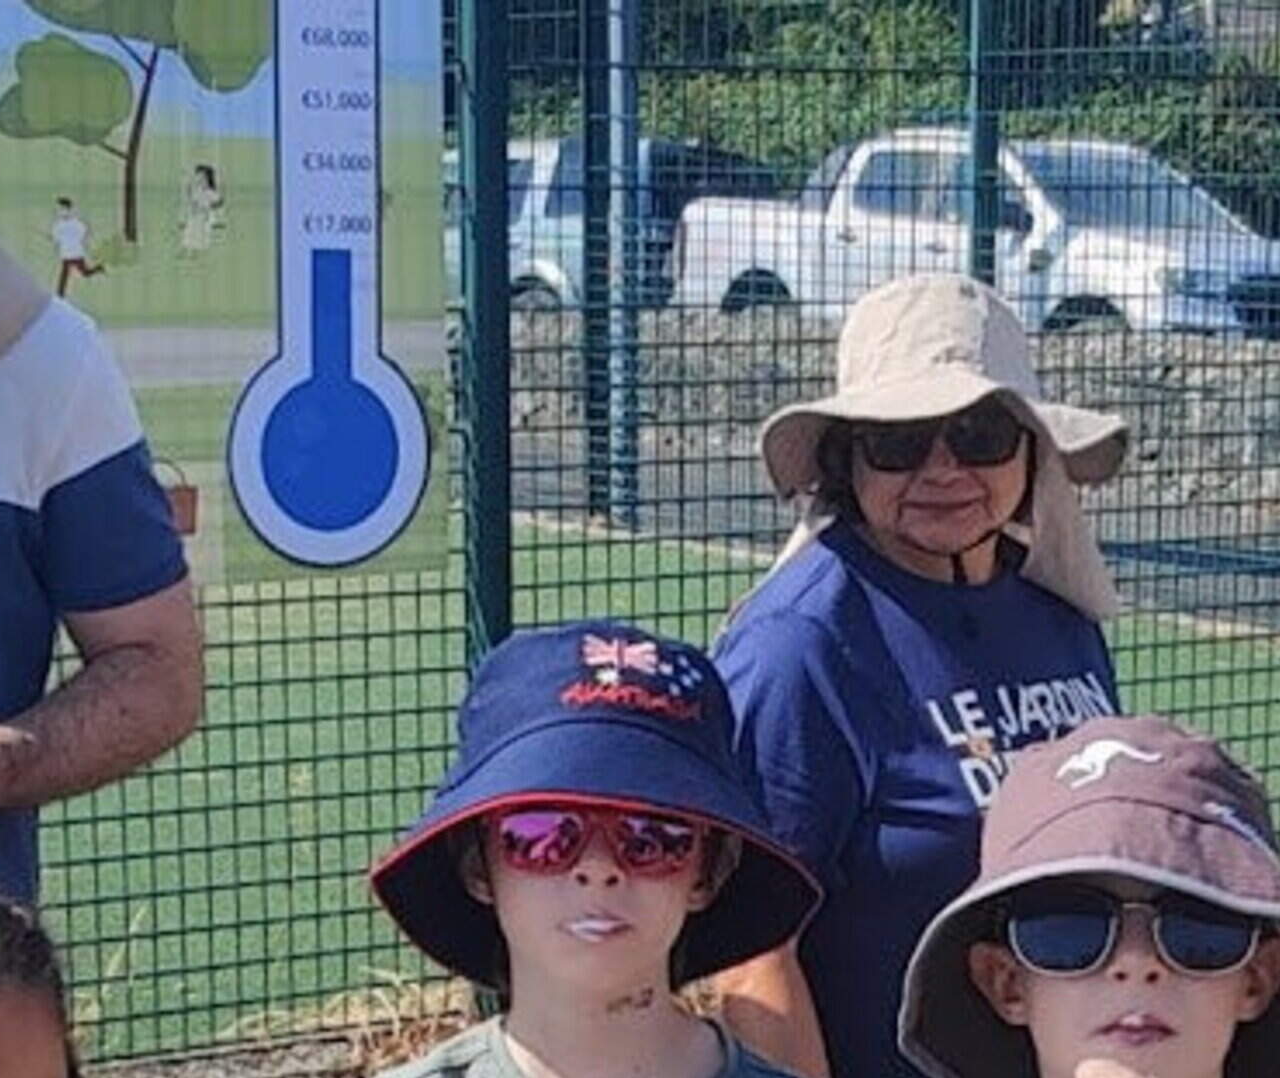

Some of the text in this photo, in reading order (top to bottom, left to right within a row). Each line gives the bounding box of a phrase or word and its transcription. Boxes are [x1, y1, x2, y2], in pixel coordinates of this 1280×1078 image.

[301, 89, 373, 111] €51,000
[927, 672, 1114, 748] LE JARDIN
